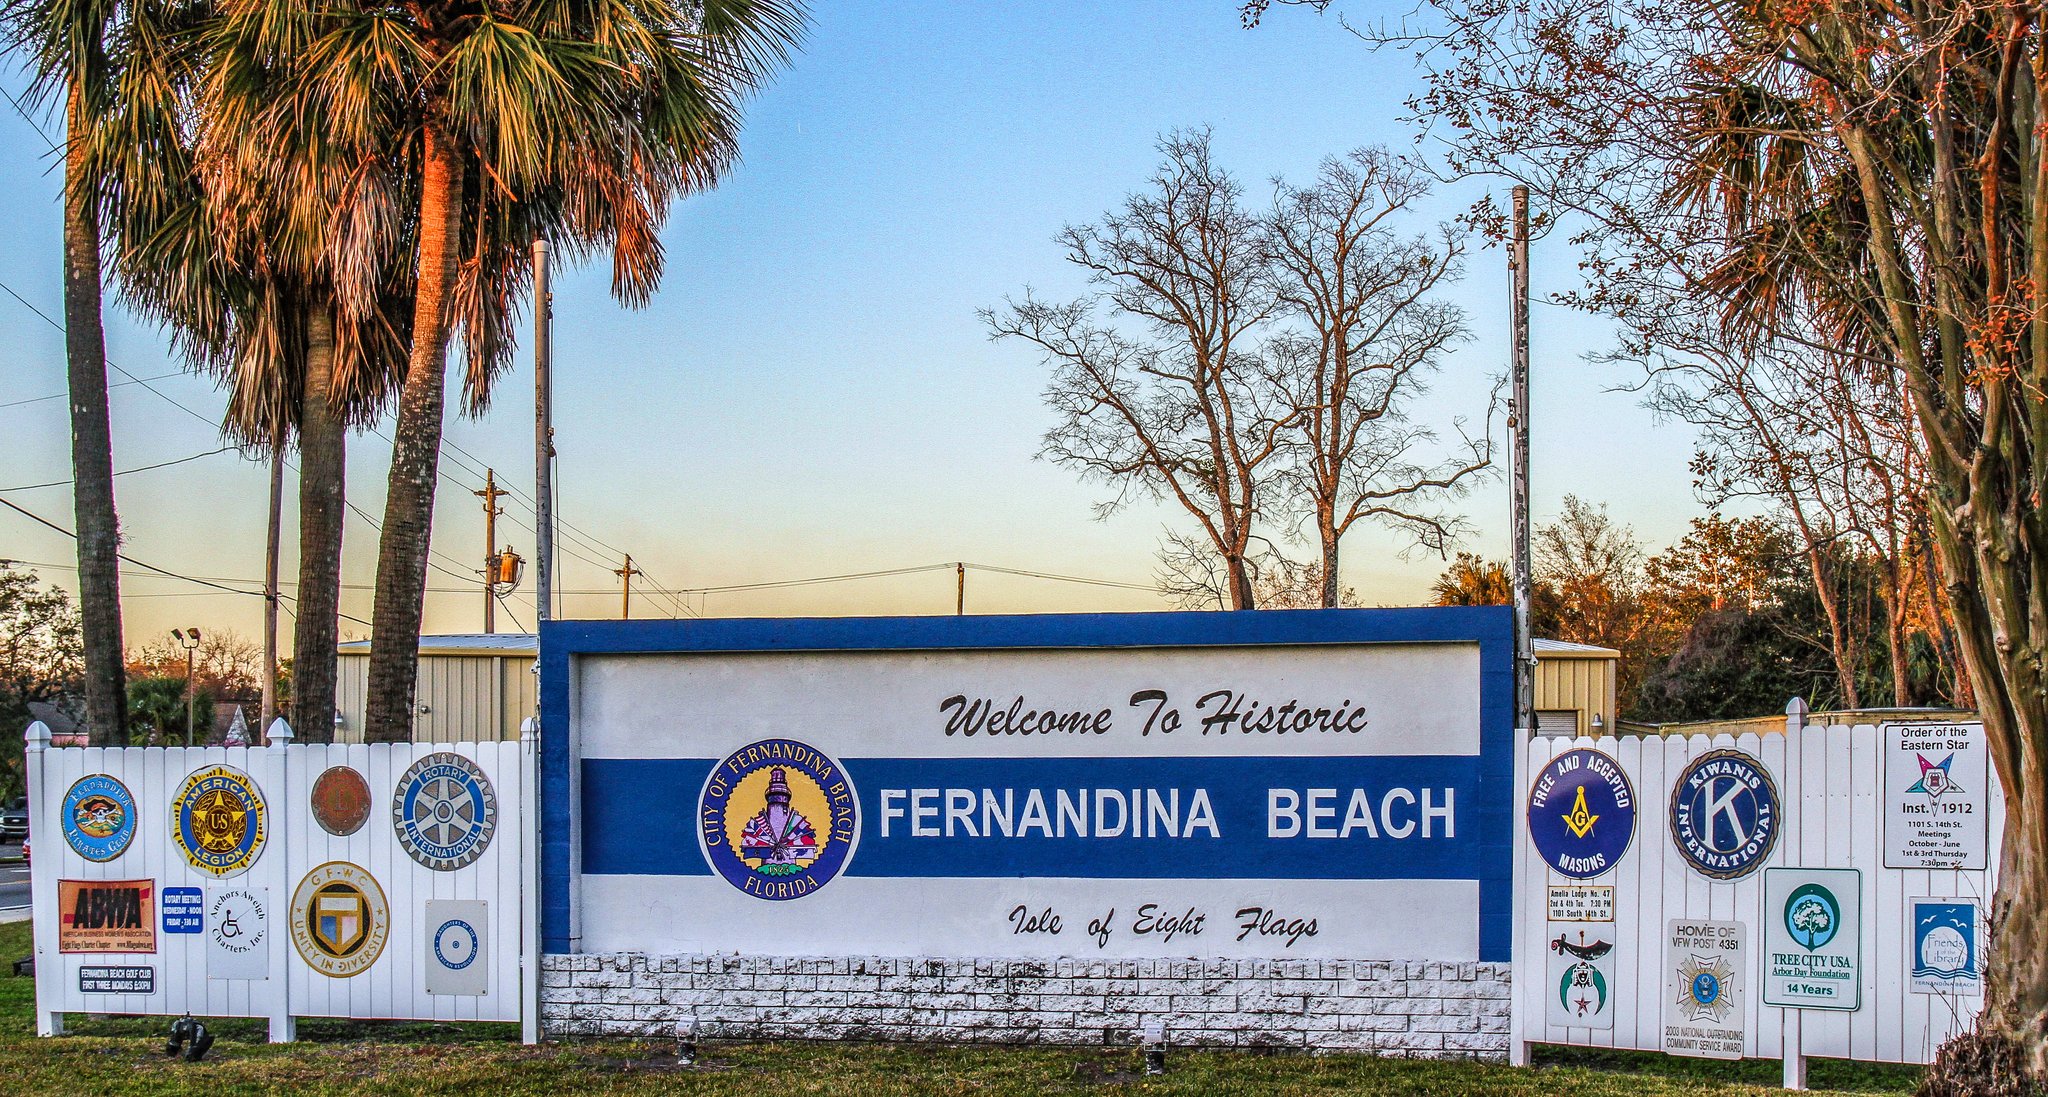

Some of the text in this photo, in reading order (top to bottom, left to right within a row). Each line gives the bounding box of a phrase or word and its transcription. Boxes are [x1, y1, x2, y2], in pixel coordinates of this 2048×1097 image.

[939, 689, 1368, 737] Welcome To Historic
[1901, 726, 1968, 738] Order of the
[1901, 739, 1970, 751] Eastern Star
[424, 766, 466, 780] ROTARY
[1689, 761, 1761, 789] KIWANIS
[1533, 755, 1630, 809] FREE AND ACCEPTED
[185, 779, 254, 812] AMERICAN
[704, 743, 855, 847] CITY OF FERNANDINA BEACH
[880, 787, 1455, 839] FERNANDINA BEACH
[1703, 777, 1749, 853] K
[1902, 802, 1973, 814] Inst. 1912
[1574, 811, 1587, 827] G
[407, 825, 480, 858] INTERNATIONAL
[1679, 803, 1771, 868] INTERNATIONAL
[1917, 830, 1952, 839] Meetings
[1943, 840, 1961, 848] June
[194, 848, 244, 865] LEGION
[1558, 852, 1606, 873] MASONS
[1934, 850, 1968, 859] Thursday
[1920, 860, 1948, 868] 7:30pm
[744, 874, 819, 898] FLORIDA
[1551, 889, 1611, 899] Amelia Lodge No. 47
[73, 887, 142, 929] ABWA
[210, 890, 266, 920] Anchors Aweigh
[1590, 900, 1601, 908] 7:30
[1603, 900, 1612, 908] PM
[1553, 909, 1564, 918] 1101
[1566, 909, 1583, 918] South
[1600, 910, 1609, 918] St.
[1007, 903, 1319, 948] Isle of Eight Flags
[1676, 925, 1736, 938] HOME OF
[249, 929, 265, 947] Inc.
[295, 919, 385, 972] UNITY IN DIVERSITY
[1672, 937, 1739, 950] VFW POST 4351
[1927, 933, 1964, 949] Friends
[1772, 953, 1801, 966] TREE
[1801, 953, 1828, 967] CITY
[109, 969, 126, 978] BEACH
[126, 969, 139, 979] GOLF
[138, 969, 152, 979] CLUB
[1772, 966, 1850, 979] Arbor Day Foundation
[82, 980, 95, 990] FIRST
[96, 980, 111, 990] THREE
[1787, 983, 1833, 996] 14 Years
[1680, 1026, 1706, 1039] NATIONAL
[1706, 1028, 1743, 1041] OUTSTANDING
[1666, 1037, 1742, 1053] COMMUNITY SERVICE AWARD
